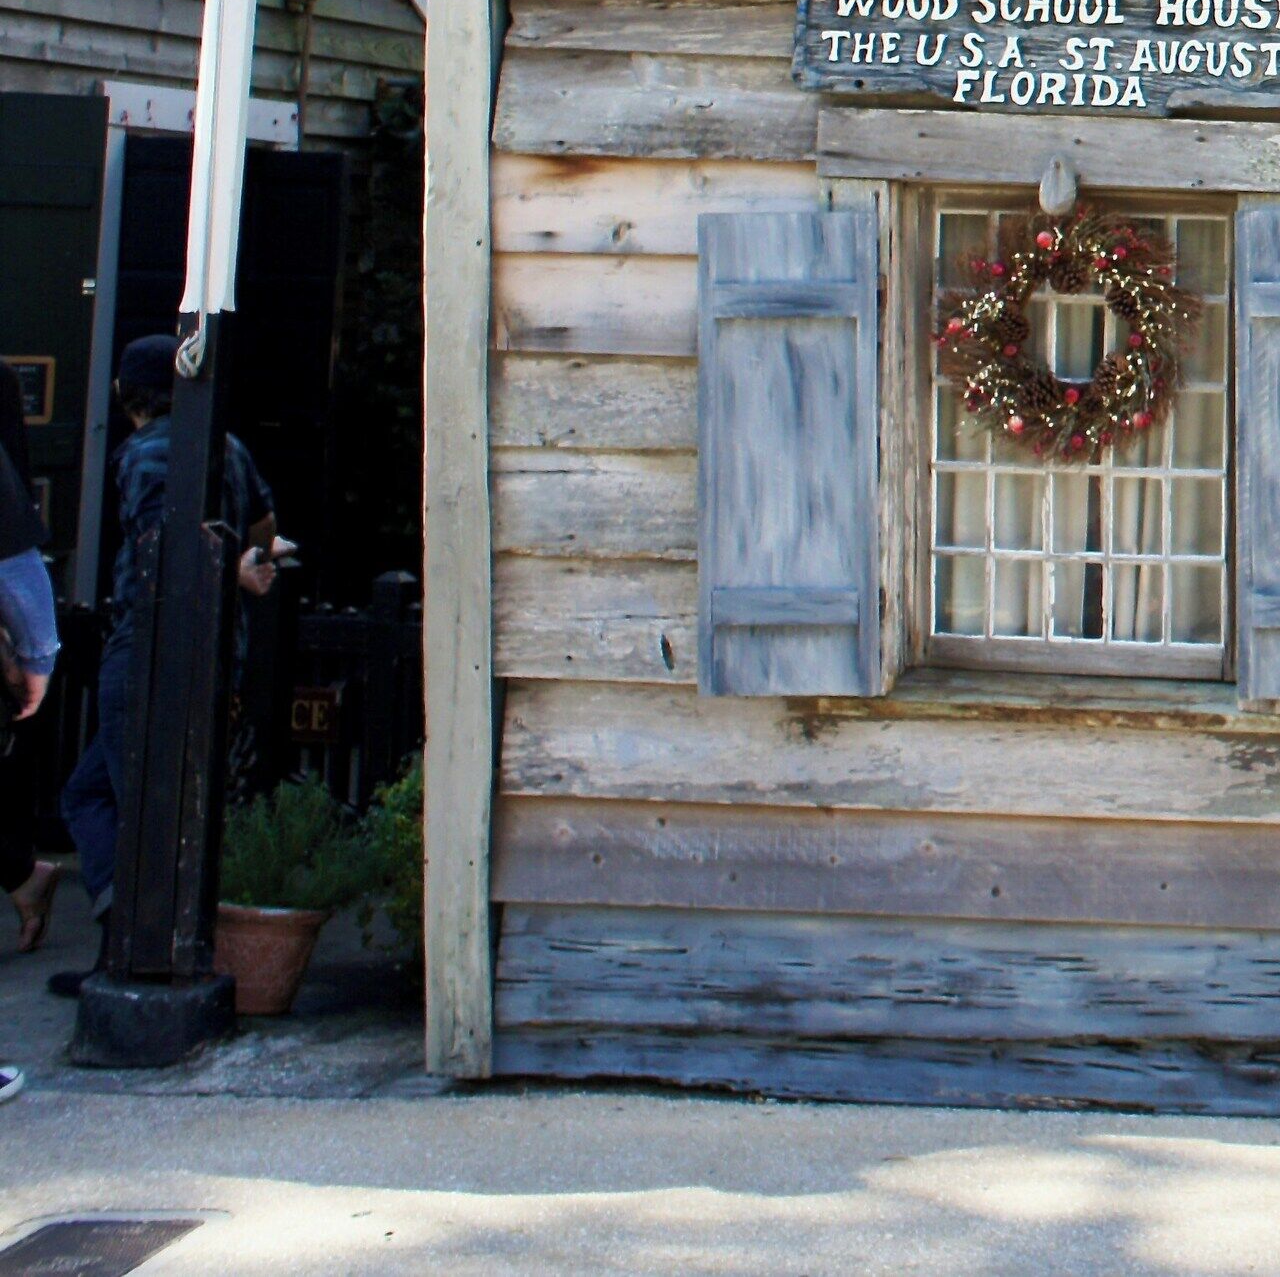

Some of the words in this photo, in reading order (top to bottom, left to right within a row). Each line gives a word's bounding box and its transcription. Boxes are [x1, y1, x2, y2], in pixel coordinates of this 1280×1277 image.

[821, 30, 901, 64] THE
[916, 32, 1037, 69] U.S.A.
[1058, 37, 1122, 72] ST.
[953, 70, 1147, 108] FLORIDA
